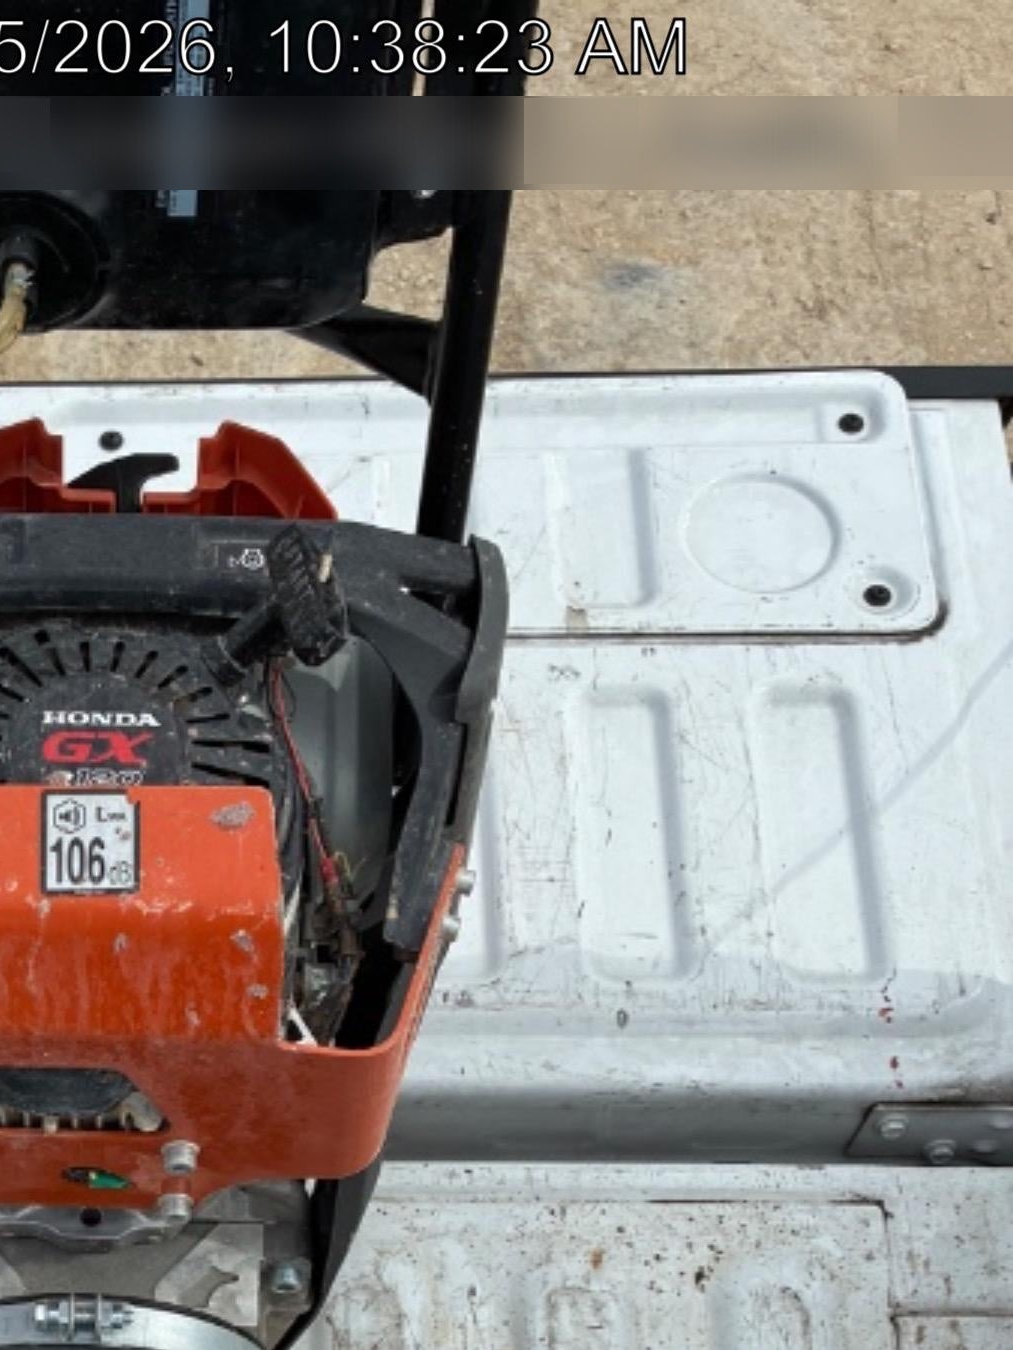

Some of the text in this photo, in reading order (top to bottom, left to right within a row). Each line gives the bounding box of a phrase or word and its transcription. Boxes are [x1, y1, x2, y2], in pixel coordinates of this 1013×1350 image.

[43, 710, 161, 727] HONDA
[43, 731, 151, 764] GX
[50, 836, 106, 885] 106
